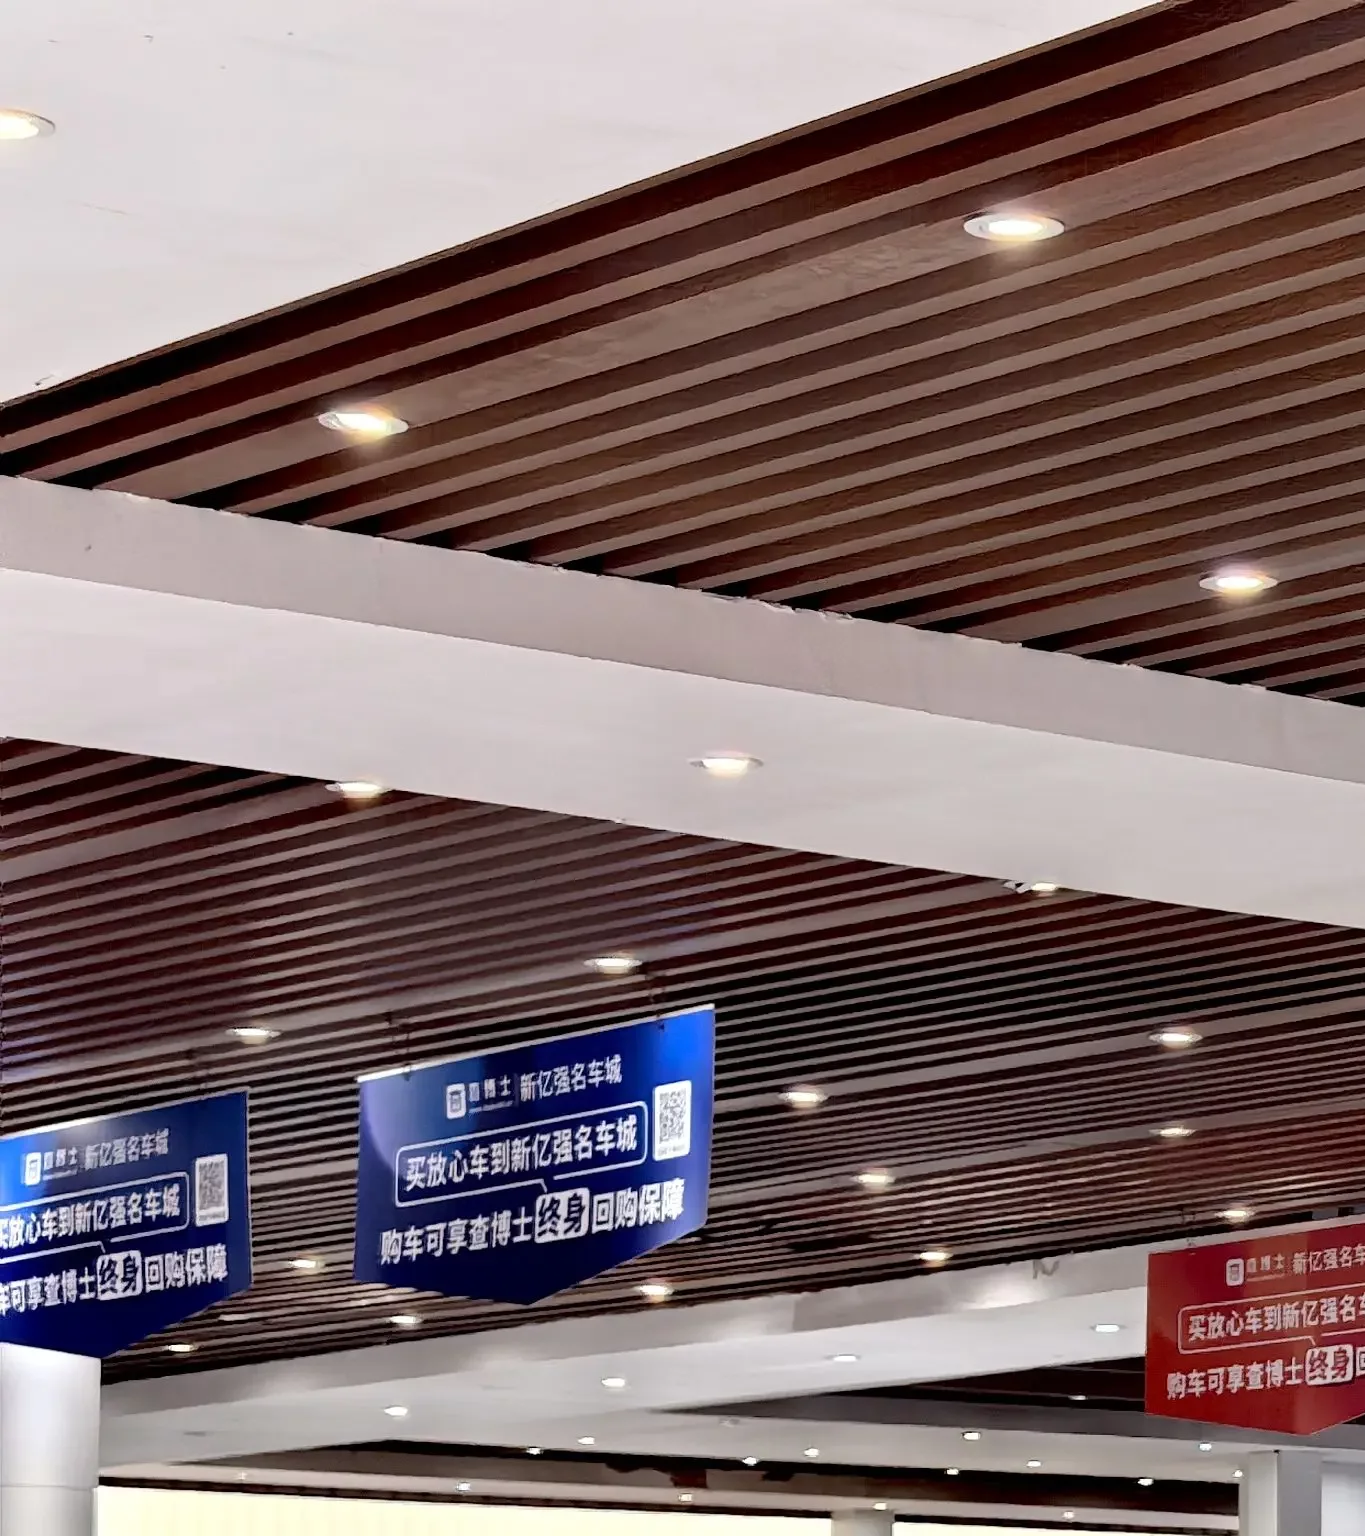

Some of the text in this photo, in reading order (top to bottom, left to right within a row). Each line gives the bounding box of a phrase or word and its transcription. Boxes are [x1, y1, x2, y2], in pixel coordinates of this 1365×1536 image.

[520, 1054, 622, 1101] 新亿强名车城
[84, 1128, 170, 1170] 新亿强名车城
[404, 1114, 638, 1193] 买放心车到新亿强名车城
